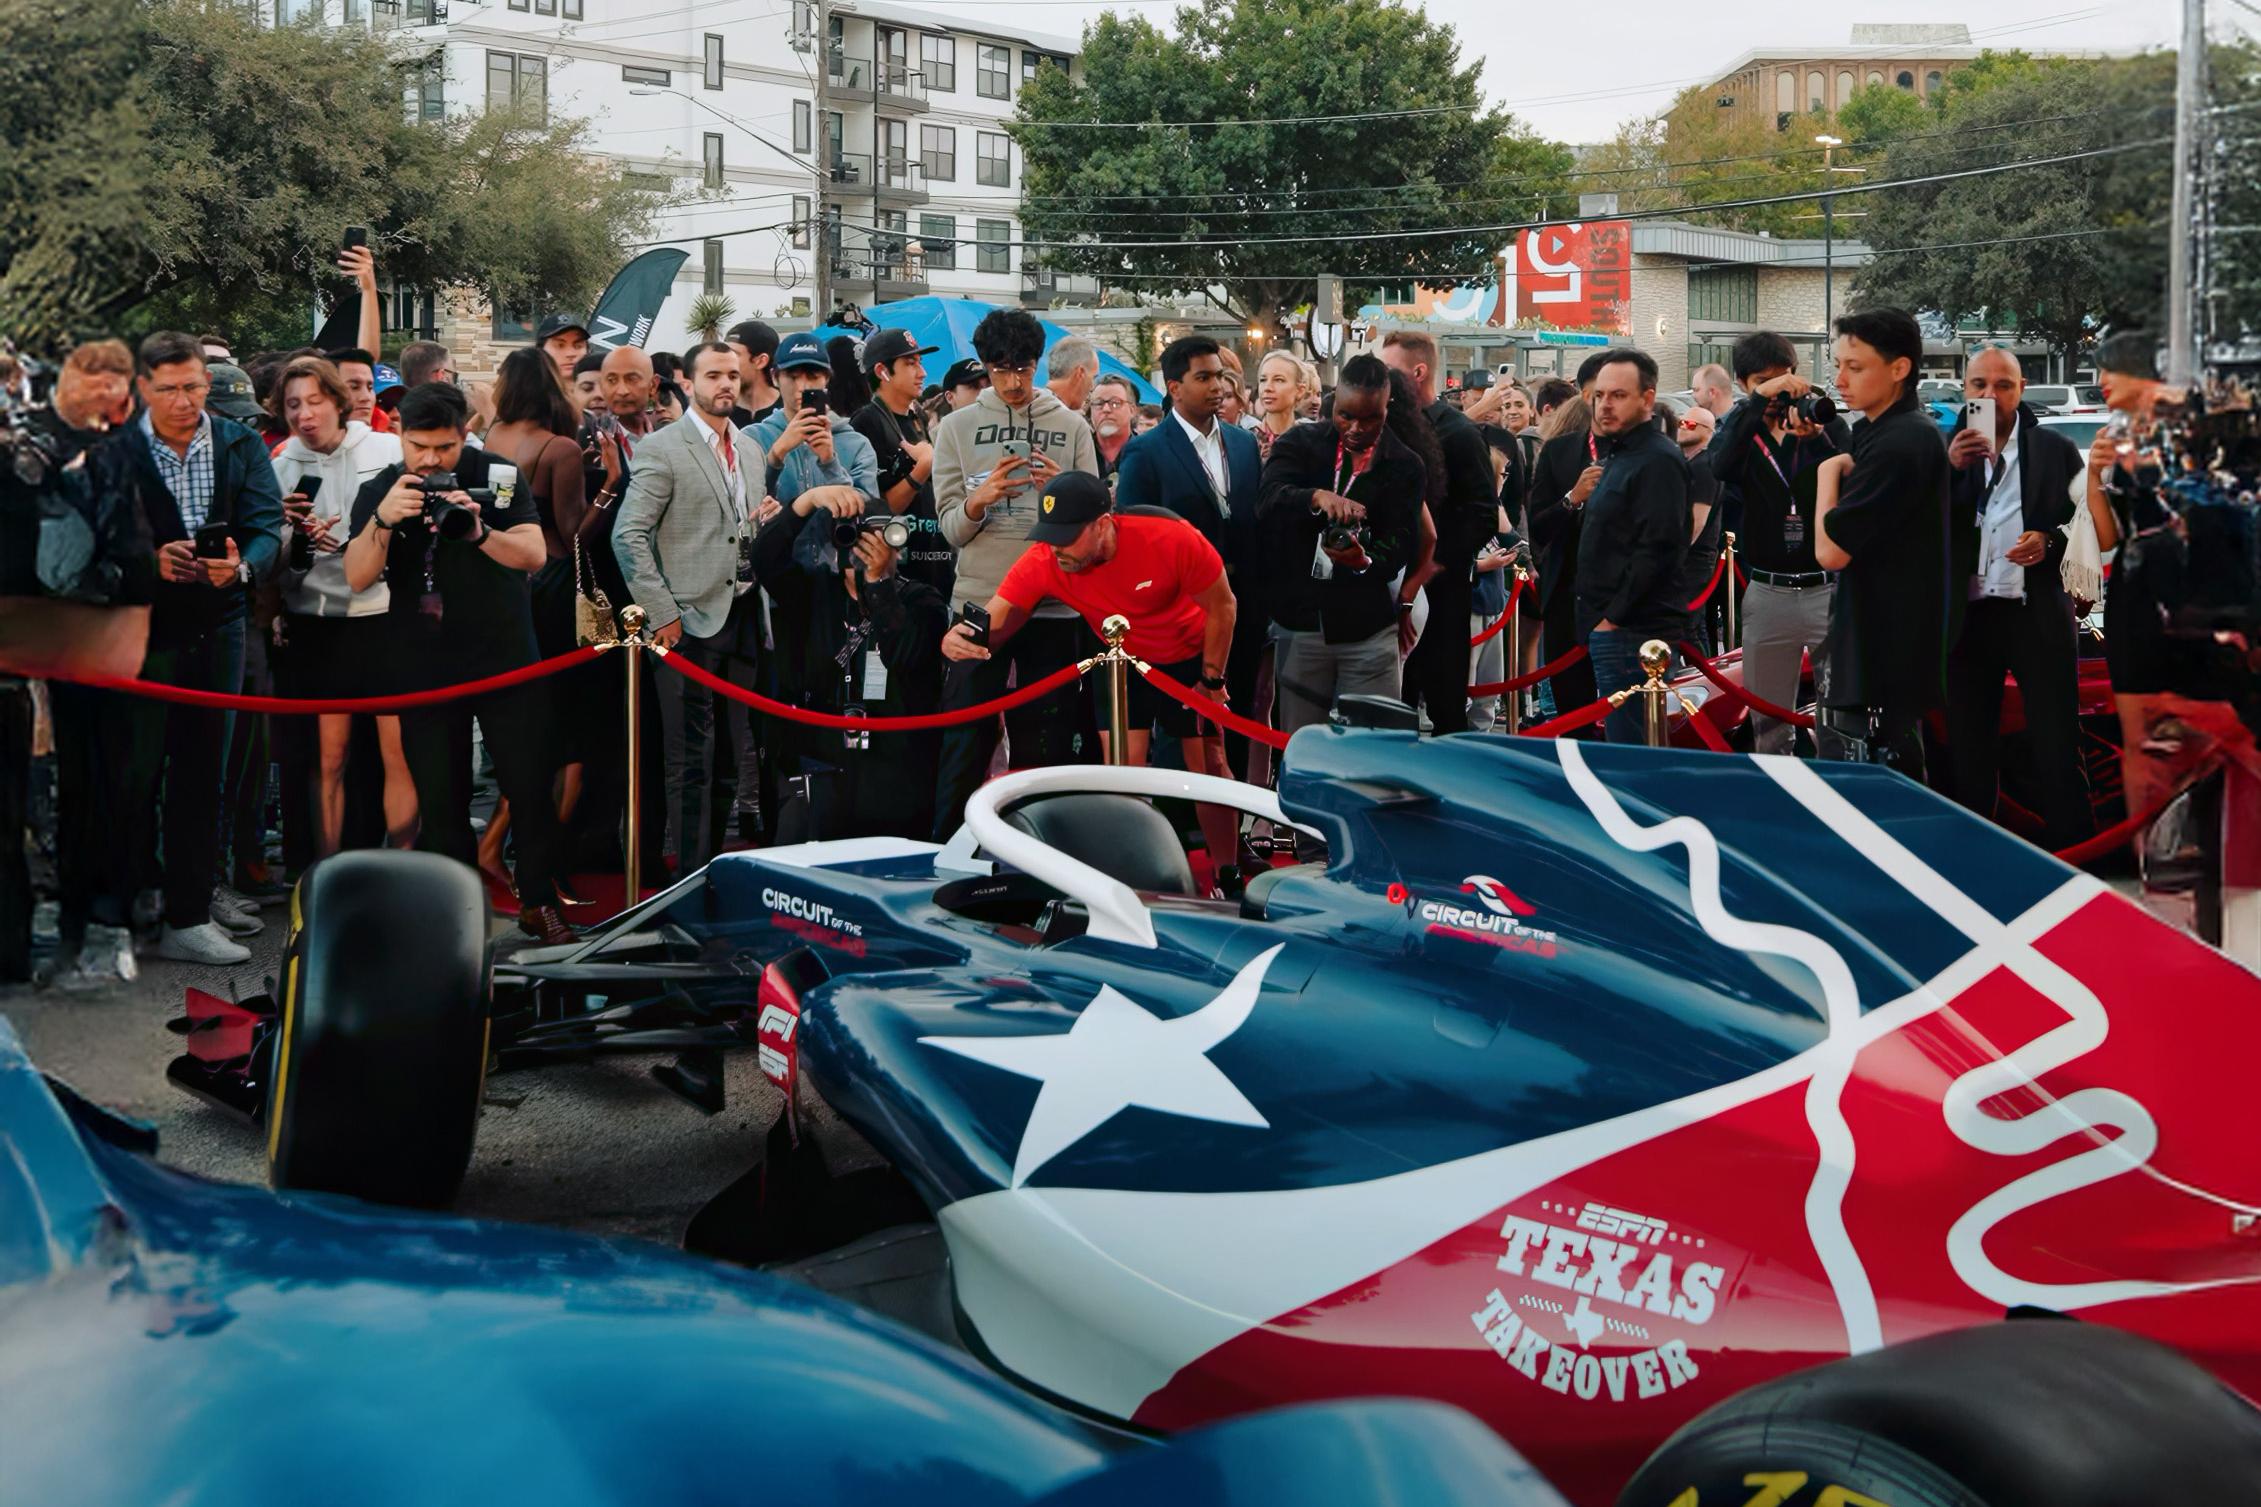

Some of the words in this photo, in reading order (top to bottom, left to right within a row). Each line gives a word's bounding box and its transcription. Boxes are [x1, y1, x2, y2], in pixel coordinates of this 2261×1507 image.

[975, 424, 1066, 452] Dodge
[762, 887, 833, 926] CIRCUIT
[1421, 903, 1519, 935] CIRCUIT
[1576, 1202, 1668, 1245] ESPN
[1496, 1214, 1725, 1325] TEXAS
[1471, 1288, 1699, 1402] TAKEOVER
